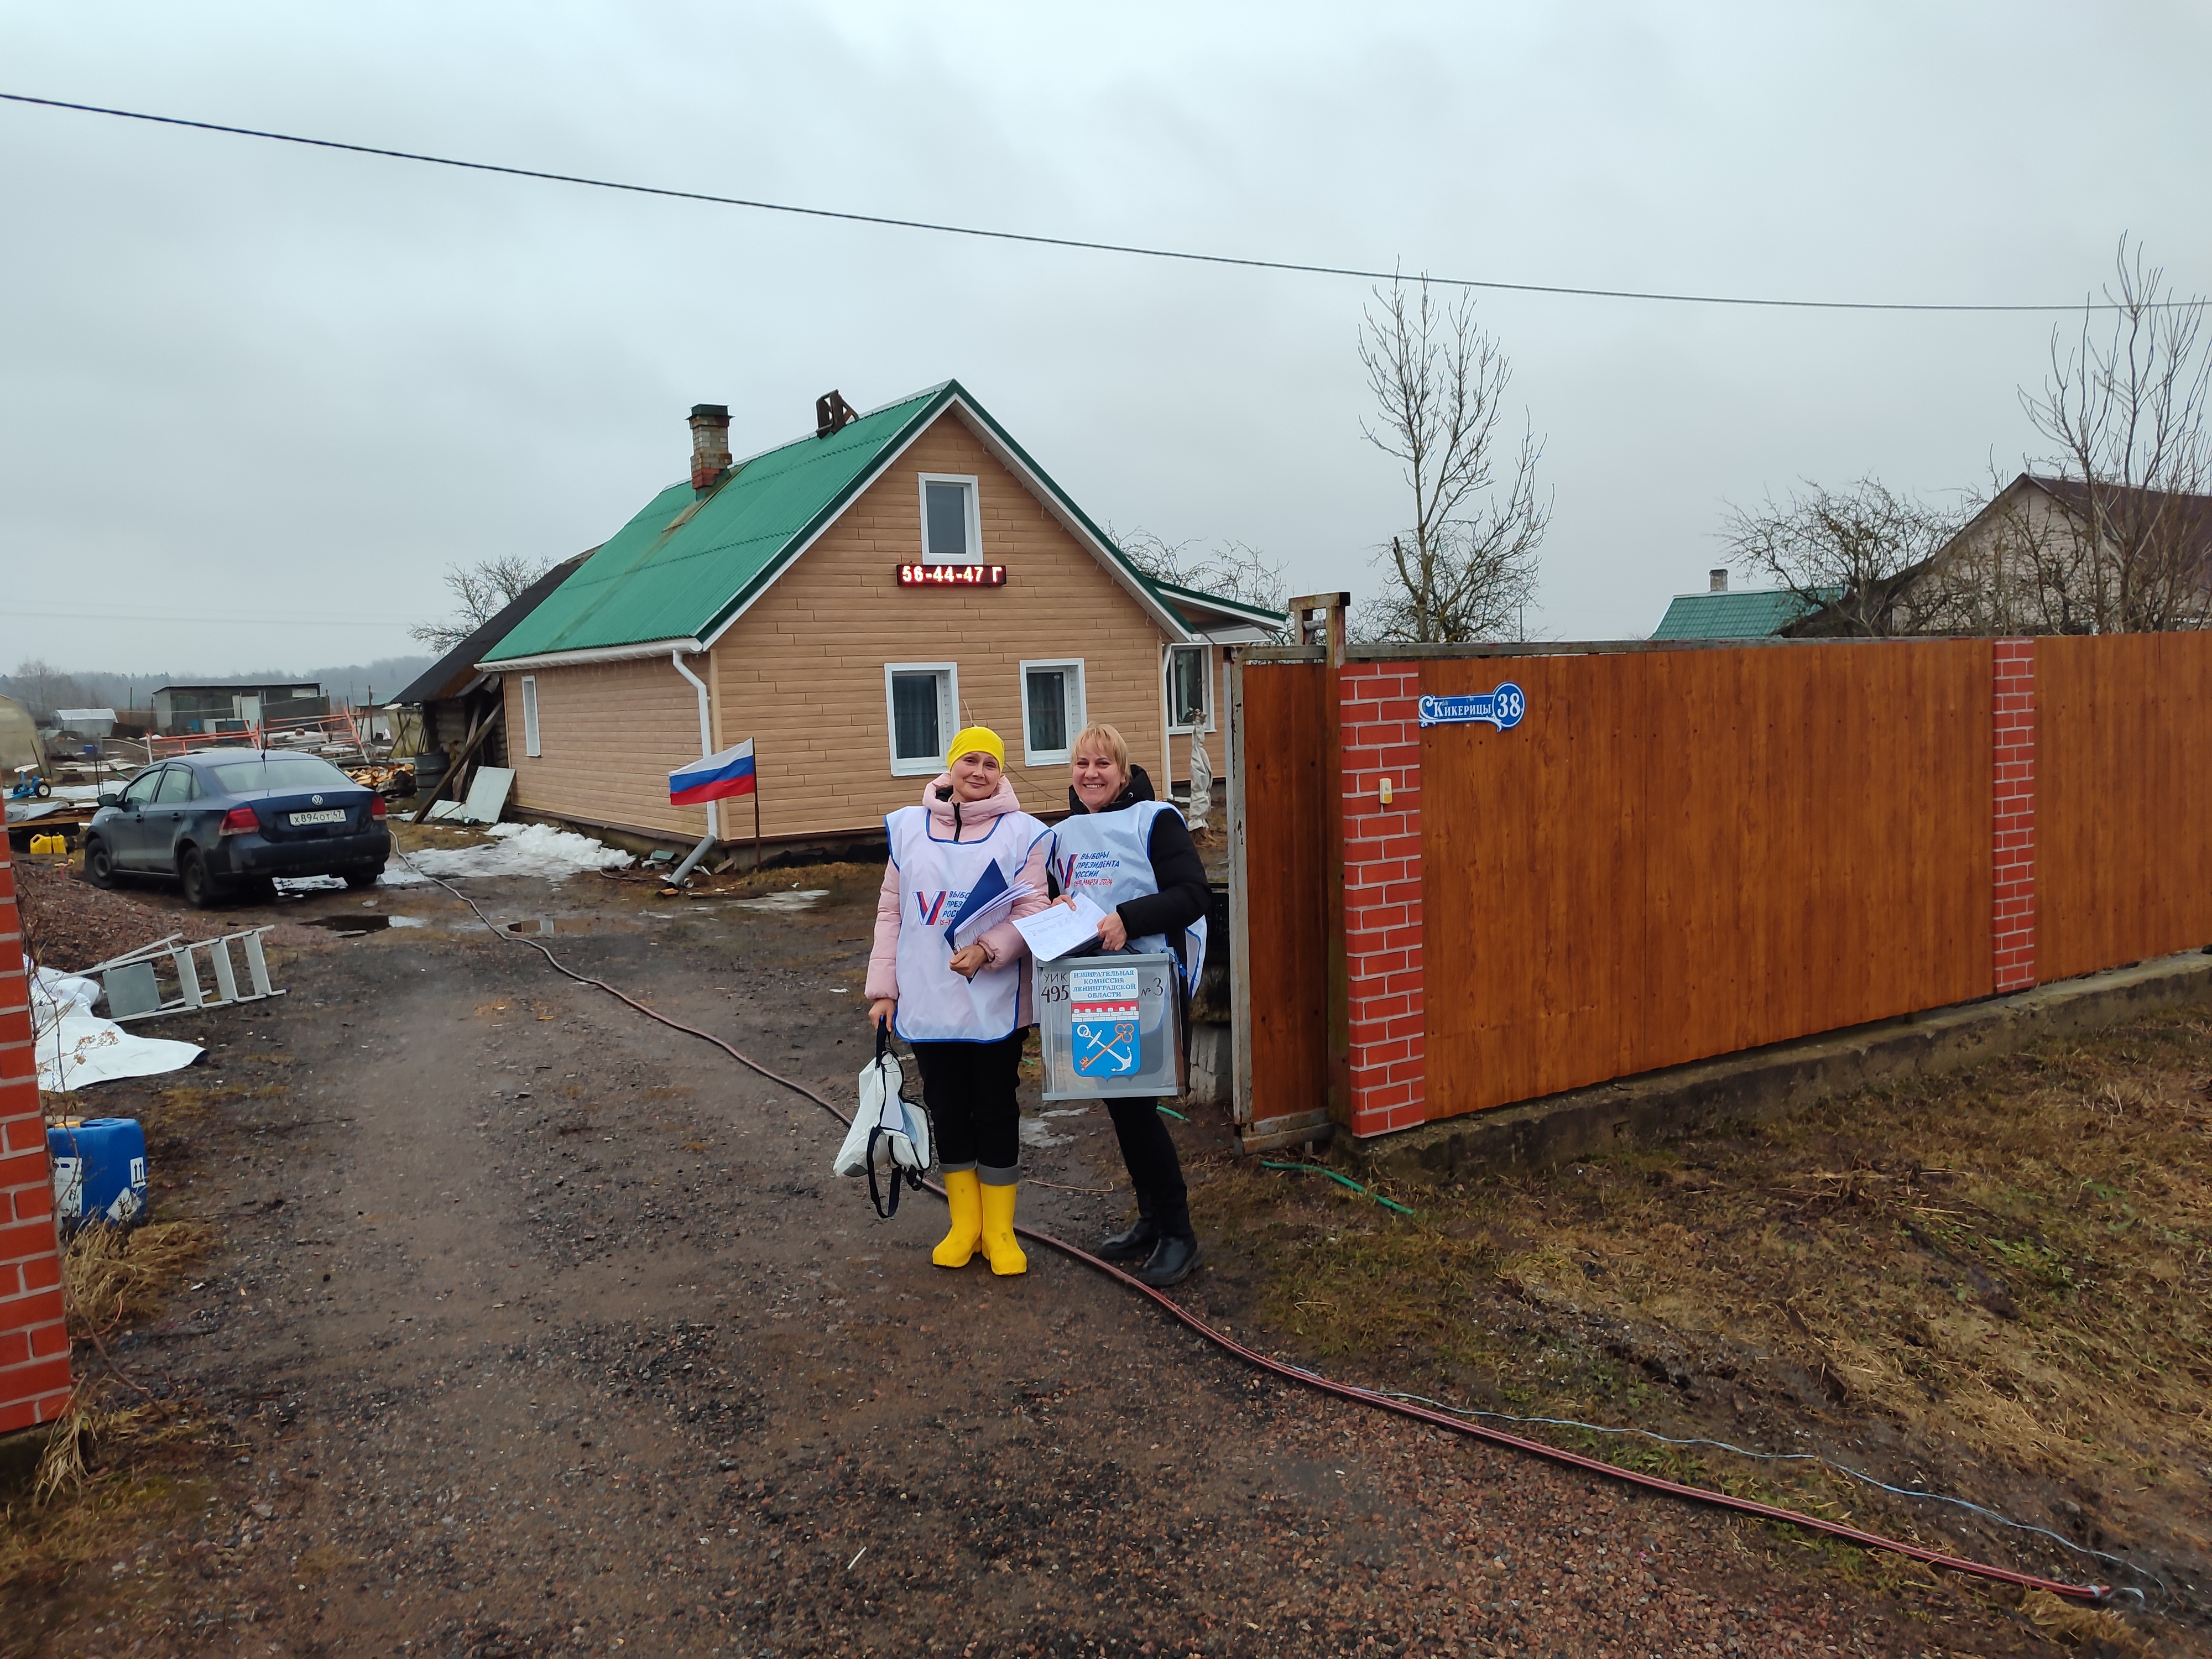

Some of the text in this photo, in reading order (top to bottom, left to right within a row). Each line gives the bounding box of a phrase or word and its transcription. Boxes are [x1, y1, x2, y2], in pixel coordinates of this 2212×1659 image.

[902, 565, 983, 582] 56-44-47
[1497, 692, 1521, 718] 38
[1080, 851, 1110, 860] ВЫБОРЫ
[1076, 860, 1120, 869] ПРЕЗИДЕНТА
[949, 890, 971, 899] ВЫБО
[1043, 973, 1067, 983] УИК
[1073, 970, 1134, 978] ИЗБИРАТЕЛЬНАЯ
[1072, 982, 1136, 992] ЛЕНИНГРАДСКОЙ
[1153, 977, 1164, 996] 3
[1041, 984, 1070, 1004] 495
